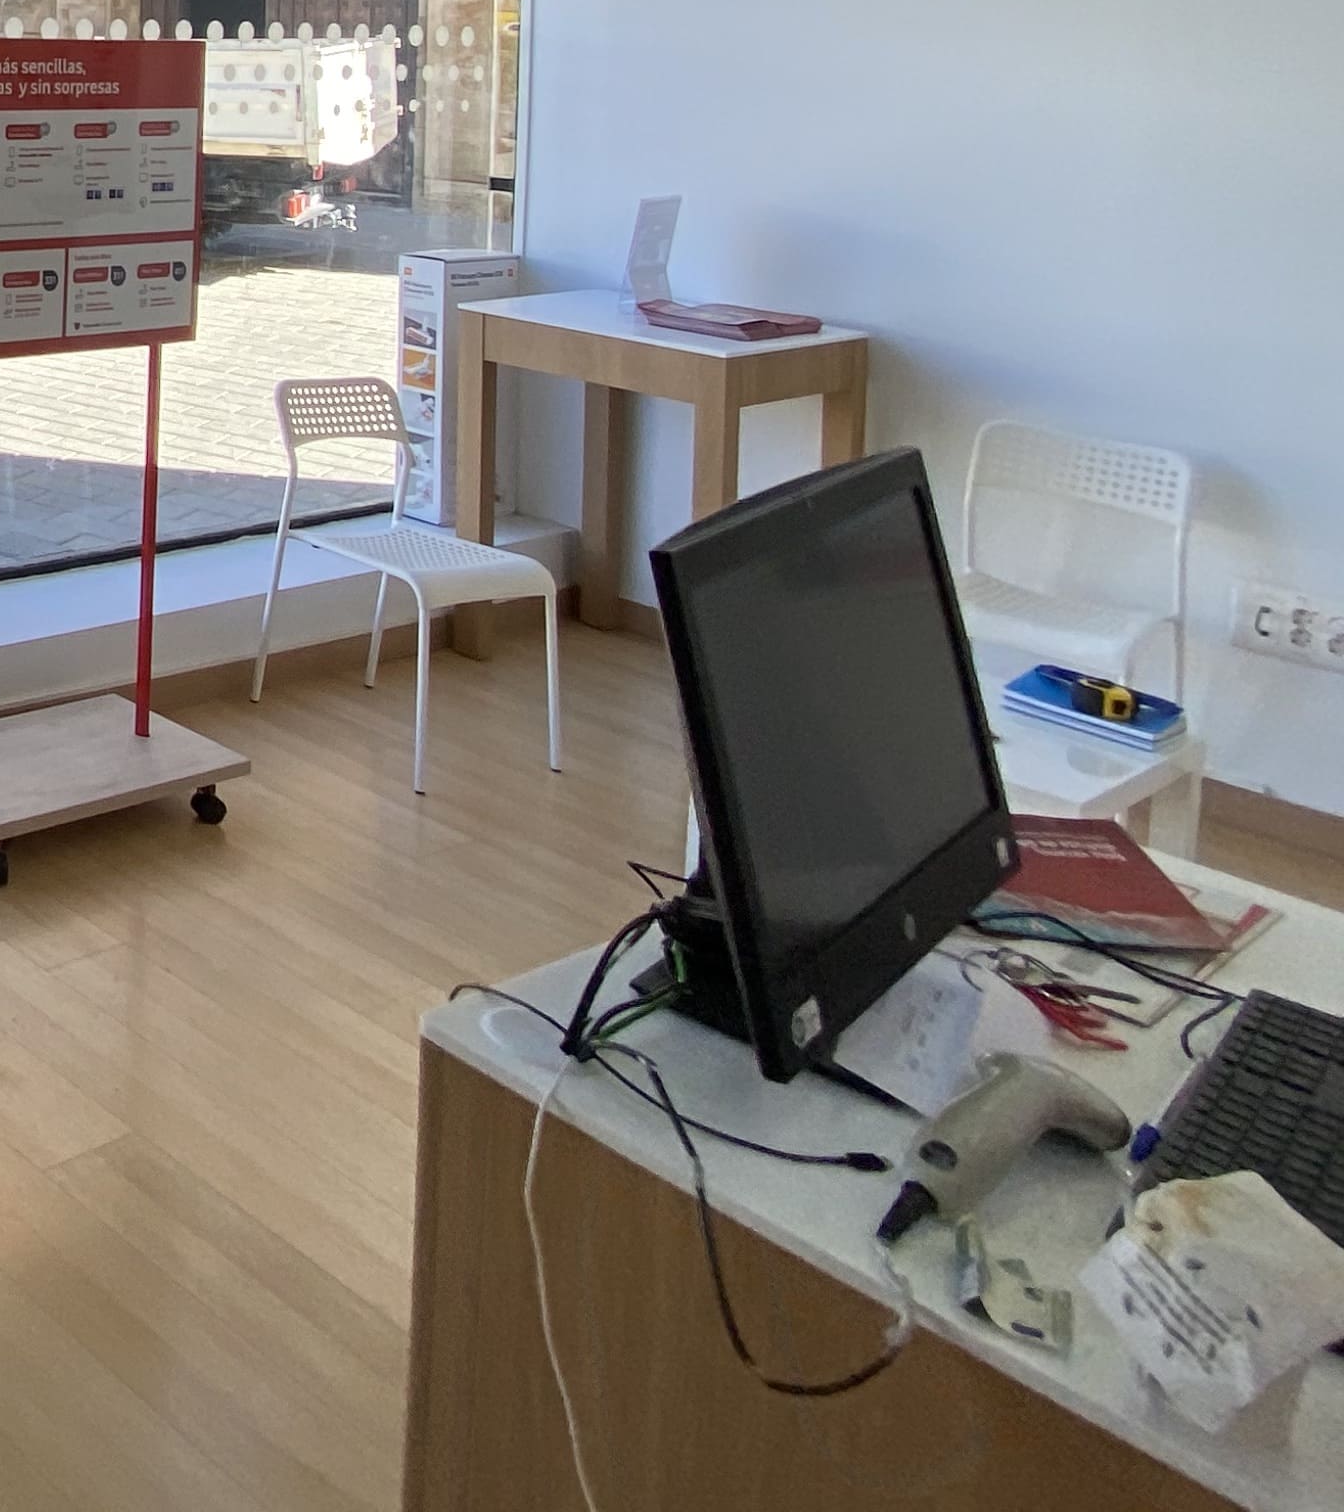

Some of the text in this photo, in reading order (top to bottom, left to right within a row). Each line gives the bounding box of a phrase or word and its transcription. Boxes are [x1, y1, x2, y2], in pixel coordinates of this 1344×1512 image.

[20, 58, 86, 76] sencillas,
[18, 82, 27, 98] y
[30, 79, 51, 95] sin
[54, 79, 120, 97] sorpresas
